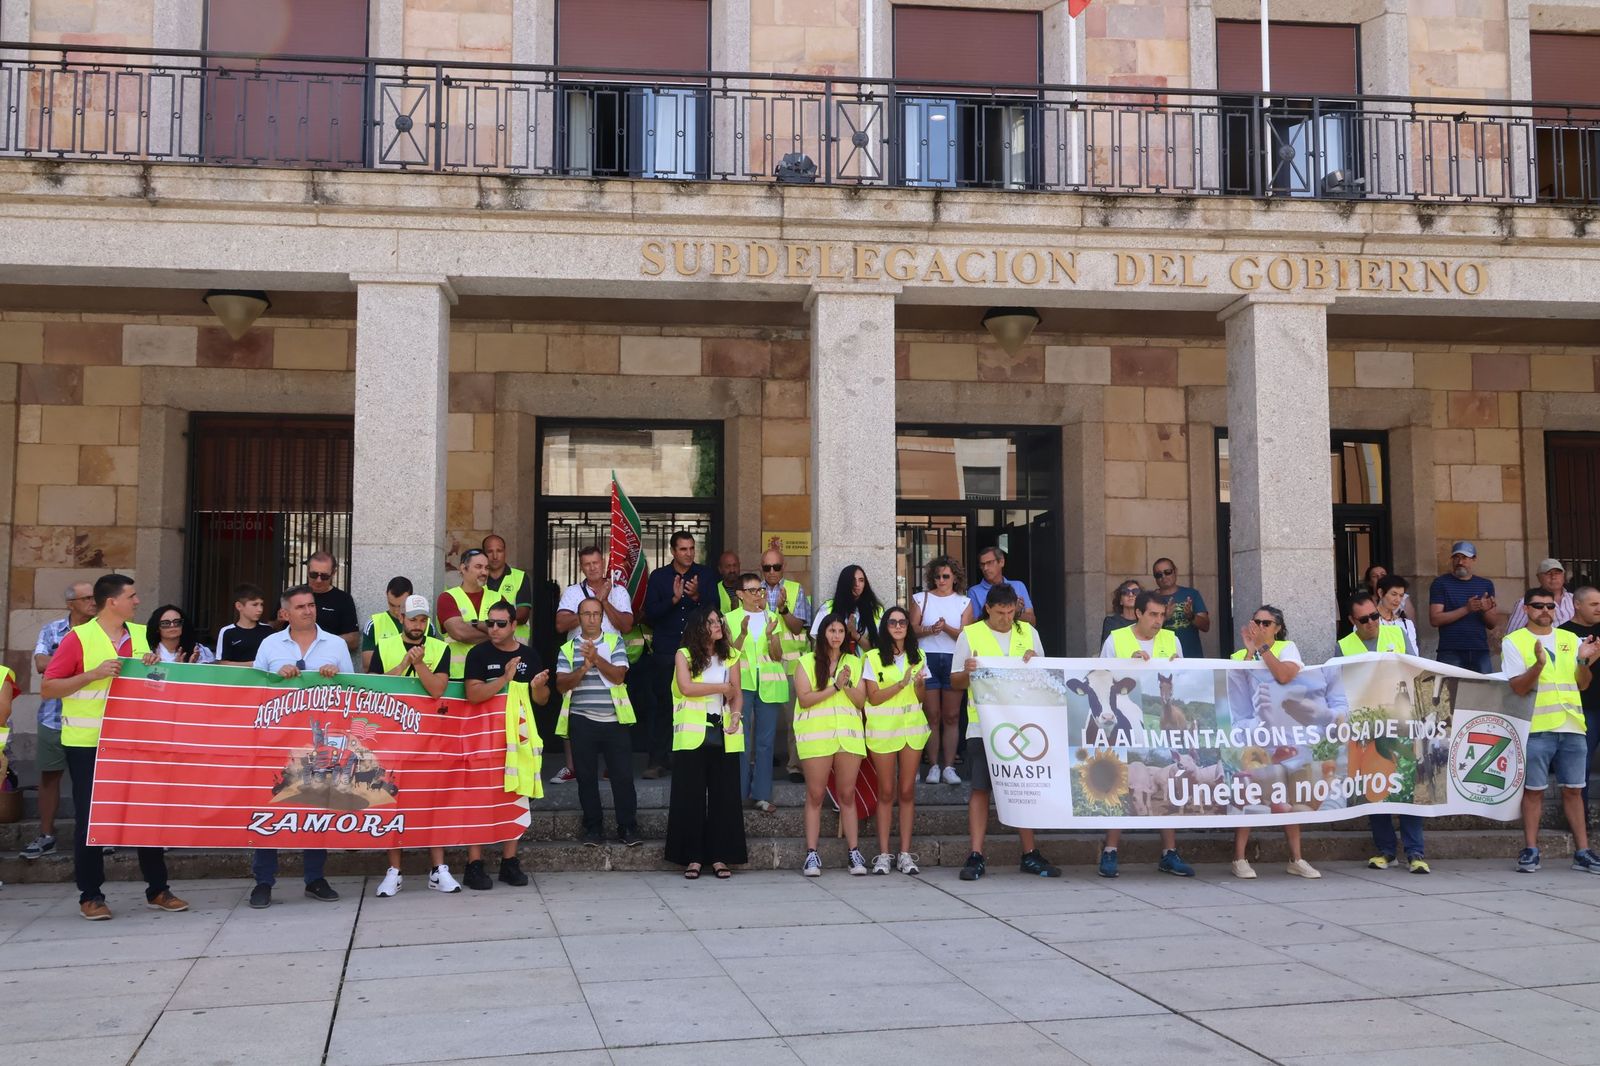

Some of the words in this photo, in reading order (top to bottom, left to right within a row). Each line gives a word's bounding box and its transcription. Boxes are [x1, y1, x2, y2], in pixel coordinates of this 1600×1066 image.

[641, 241, 1080, 285] SUBDELEGACION
[1114, 252, 1208, 288] DEL
[1229, 254, 1489, 295] GOBIERNO
[254, 684, 343, 729] AGRICULTORES
[355, 688, 422, 734] GANADEROS
[1081, 728, 1110, 748] LA
[1115, 719, 1287, 749] ALIMENTACIÓN
[1293, 724, 1321, 746] ES
[1325, 720, 1371, 744] COSA
[1374, 719, 1399, 739] DE
[1462, 731, 1513, 791] Z
[1465, 745, 1475, 760] A
[1496, 755, 1508, 773] G
[991, 763, 1052, 780] UNASPI
[1167, 768, 1263, 807] Únete
[1270, 781, 1287, 804] a
[1295, 771, 1403, 803] nosotros
[1468, 793, 1495, 802] ZAMORA
[247, 811, 406, 838] ZAMORA
